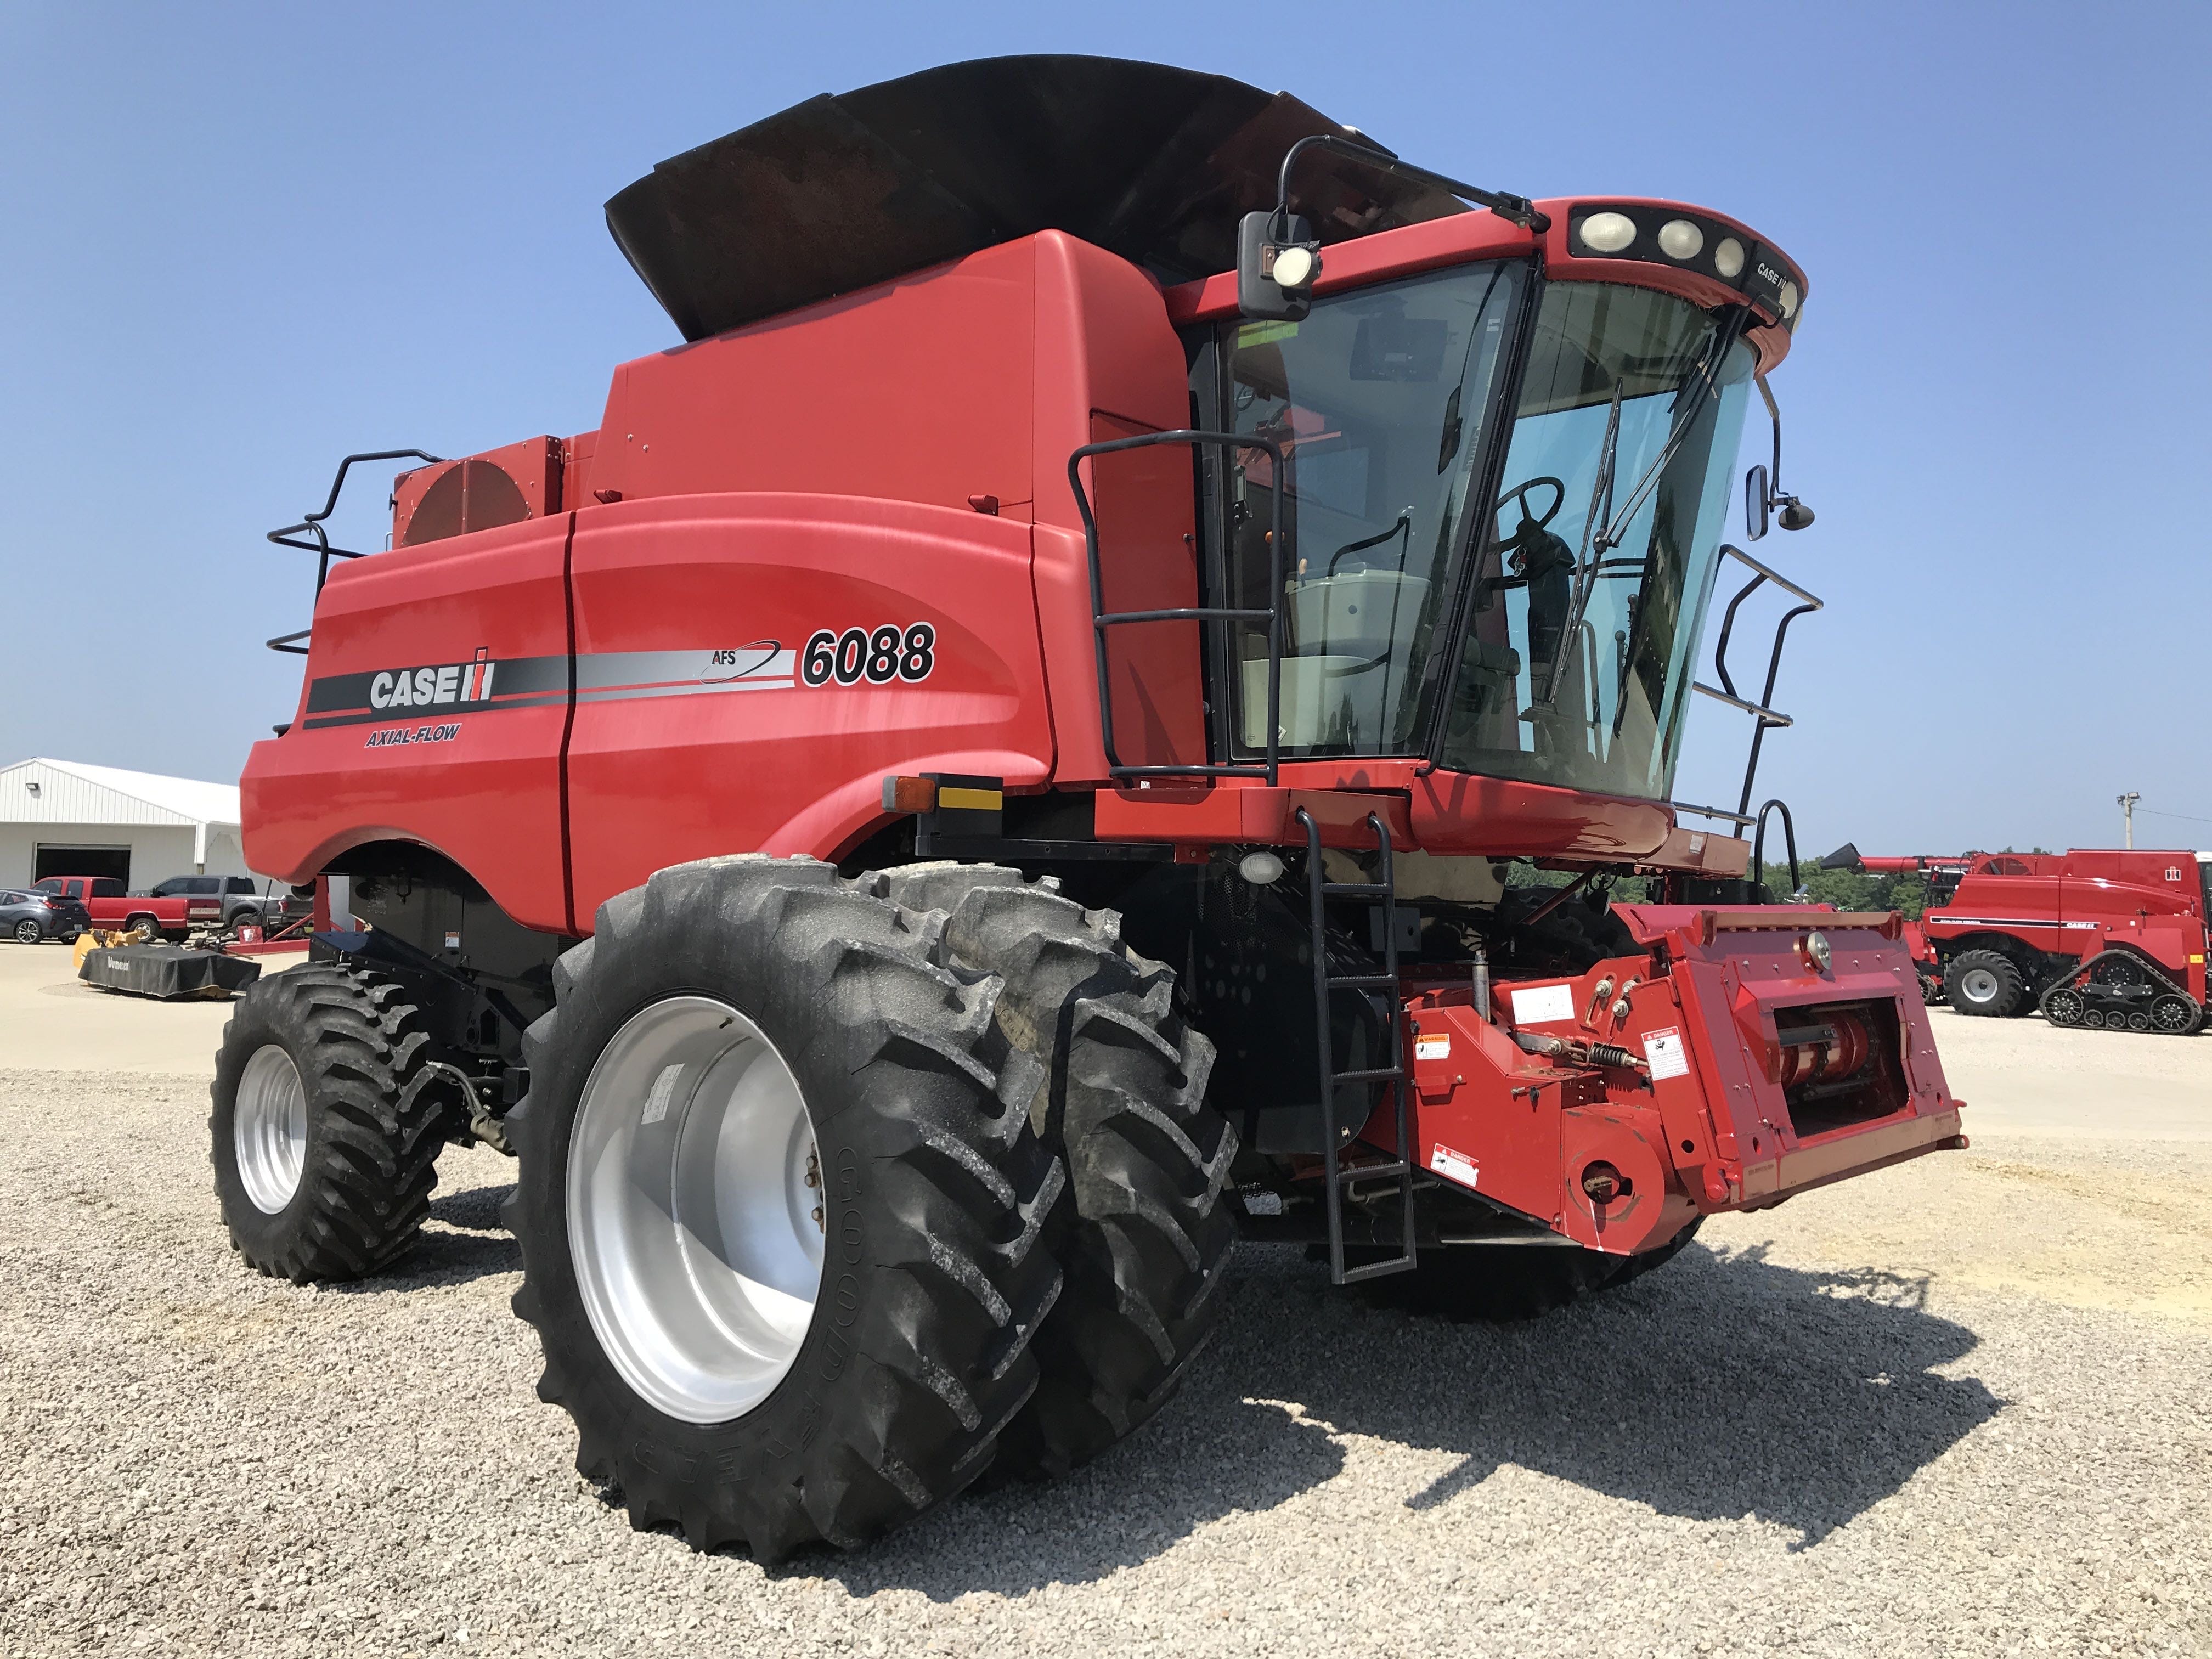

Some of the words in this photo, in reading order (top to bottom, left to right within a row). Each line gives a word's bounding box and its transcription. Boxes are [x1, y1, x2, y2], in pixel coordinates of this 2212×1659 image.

[1758, 263, 1779, 284] CASE
[712, 650, 736, 665] AFS
[802, 622, 936, 687] 6088
[370, 666, 460, 709] CASE
[364, 723, 462, 748] AXIAL-FLOW
[1450, 1152, 1471, 1164] DANGER
